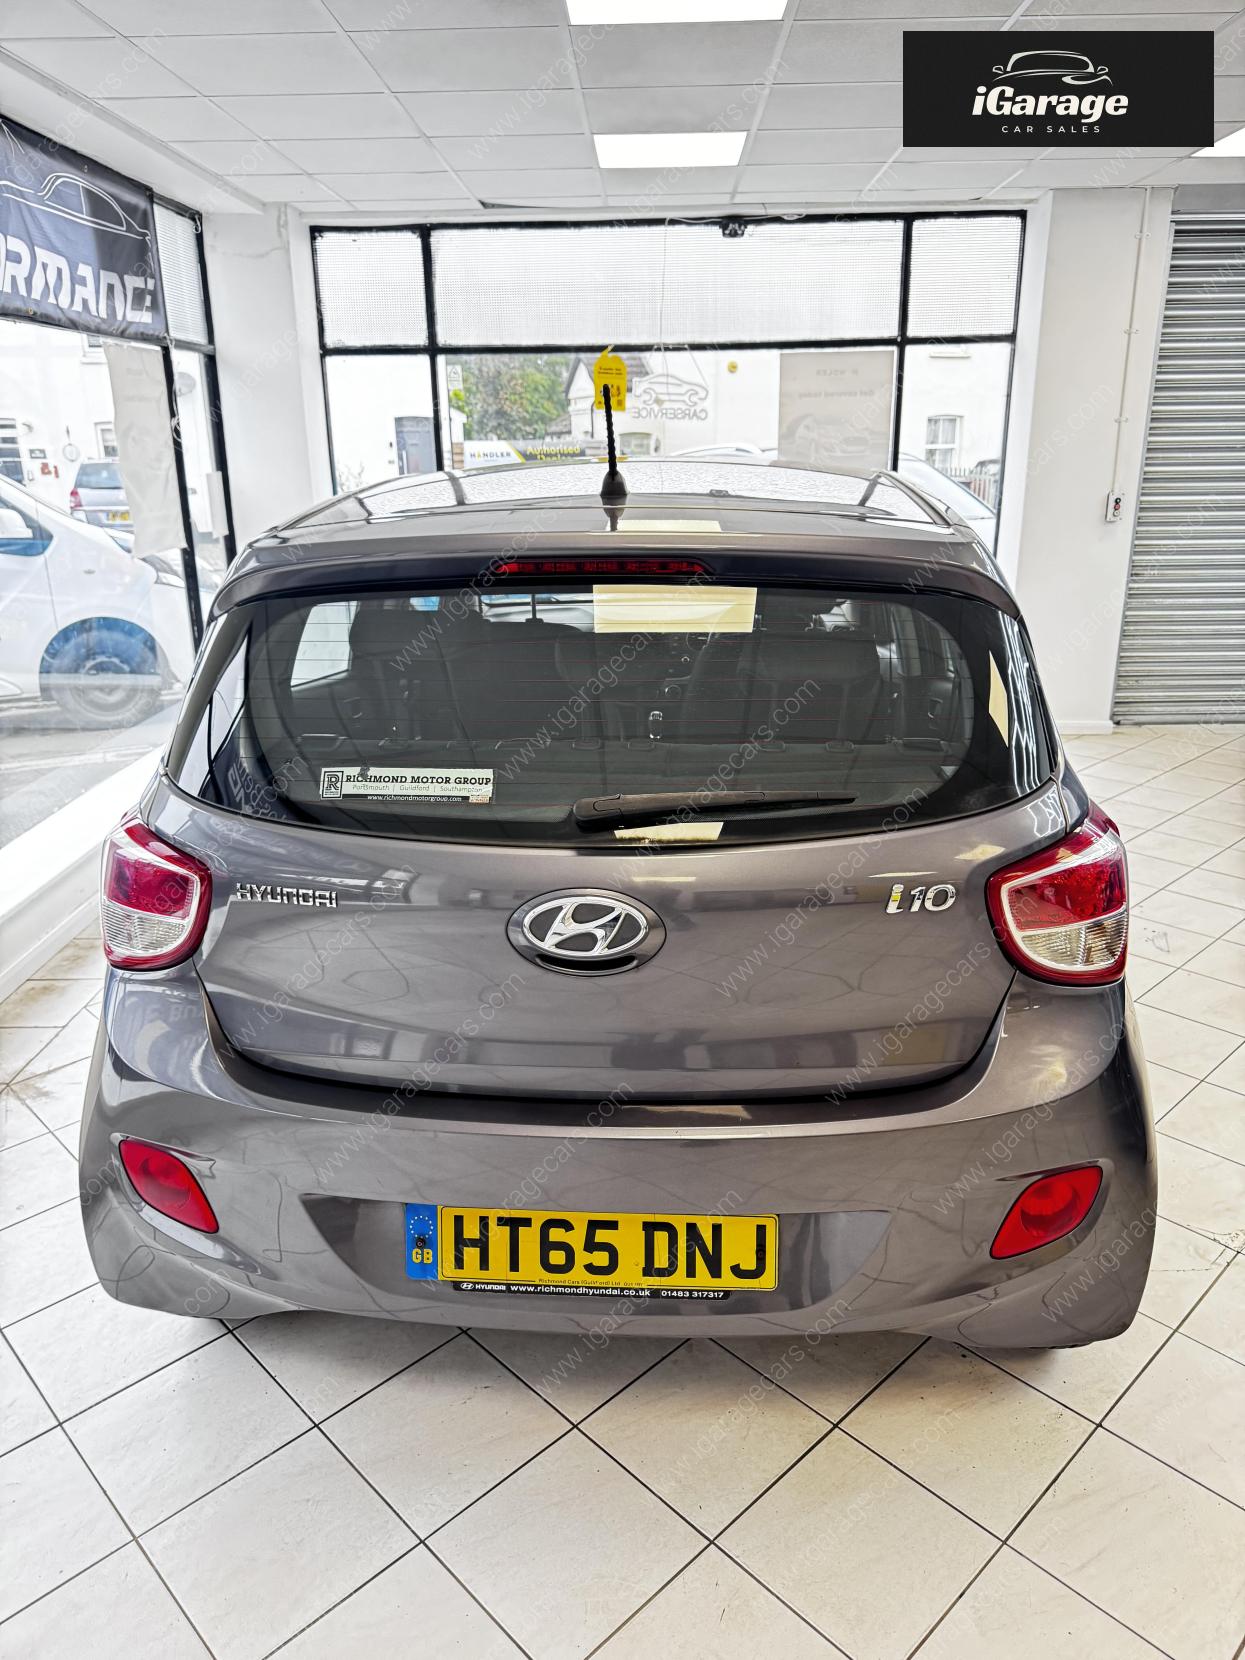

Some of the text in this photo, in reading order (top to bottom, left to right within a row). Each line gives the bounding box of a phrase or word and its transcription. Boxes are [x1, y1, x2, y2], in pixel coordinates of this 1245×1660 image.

[411, 776, 451, 784] MOTOR
[454, 776, 491, 785] GROUP
[236, 882, 337, 908] HYUNDAI
[886, 883, 956, 914] i10
[412, 1248, 433, 1263] GB
[454, 1214, 767, 1280] HT65 DNJ
[510, 1285, 651, 1297] www.richmondhyundai.co.uk
[661, 1290, 690, 1298] 01483
[692, 1291, 724, 1299] 317317
